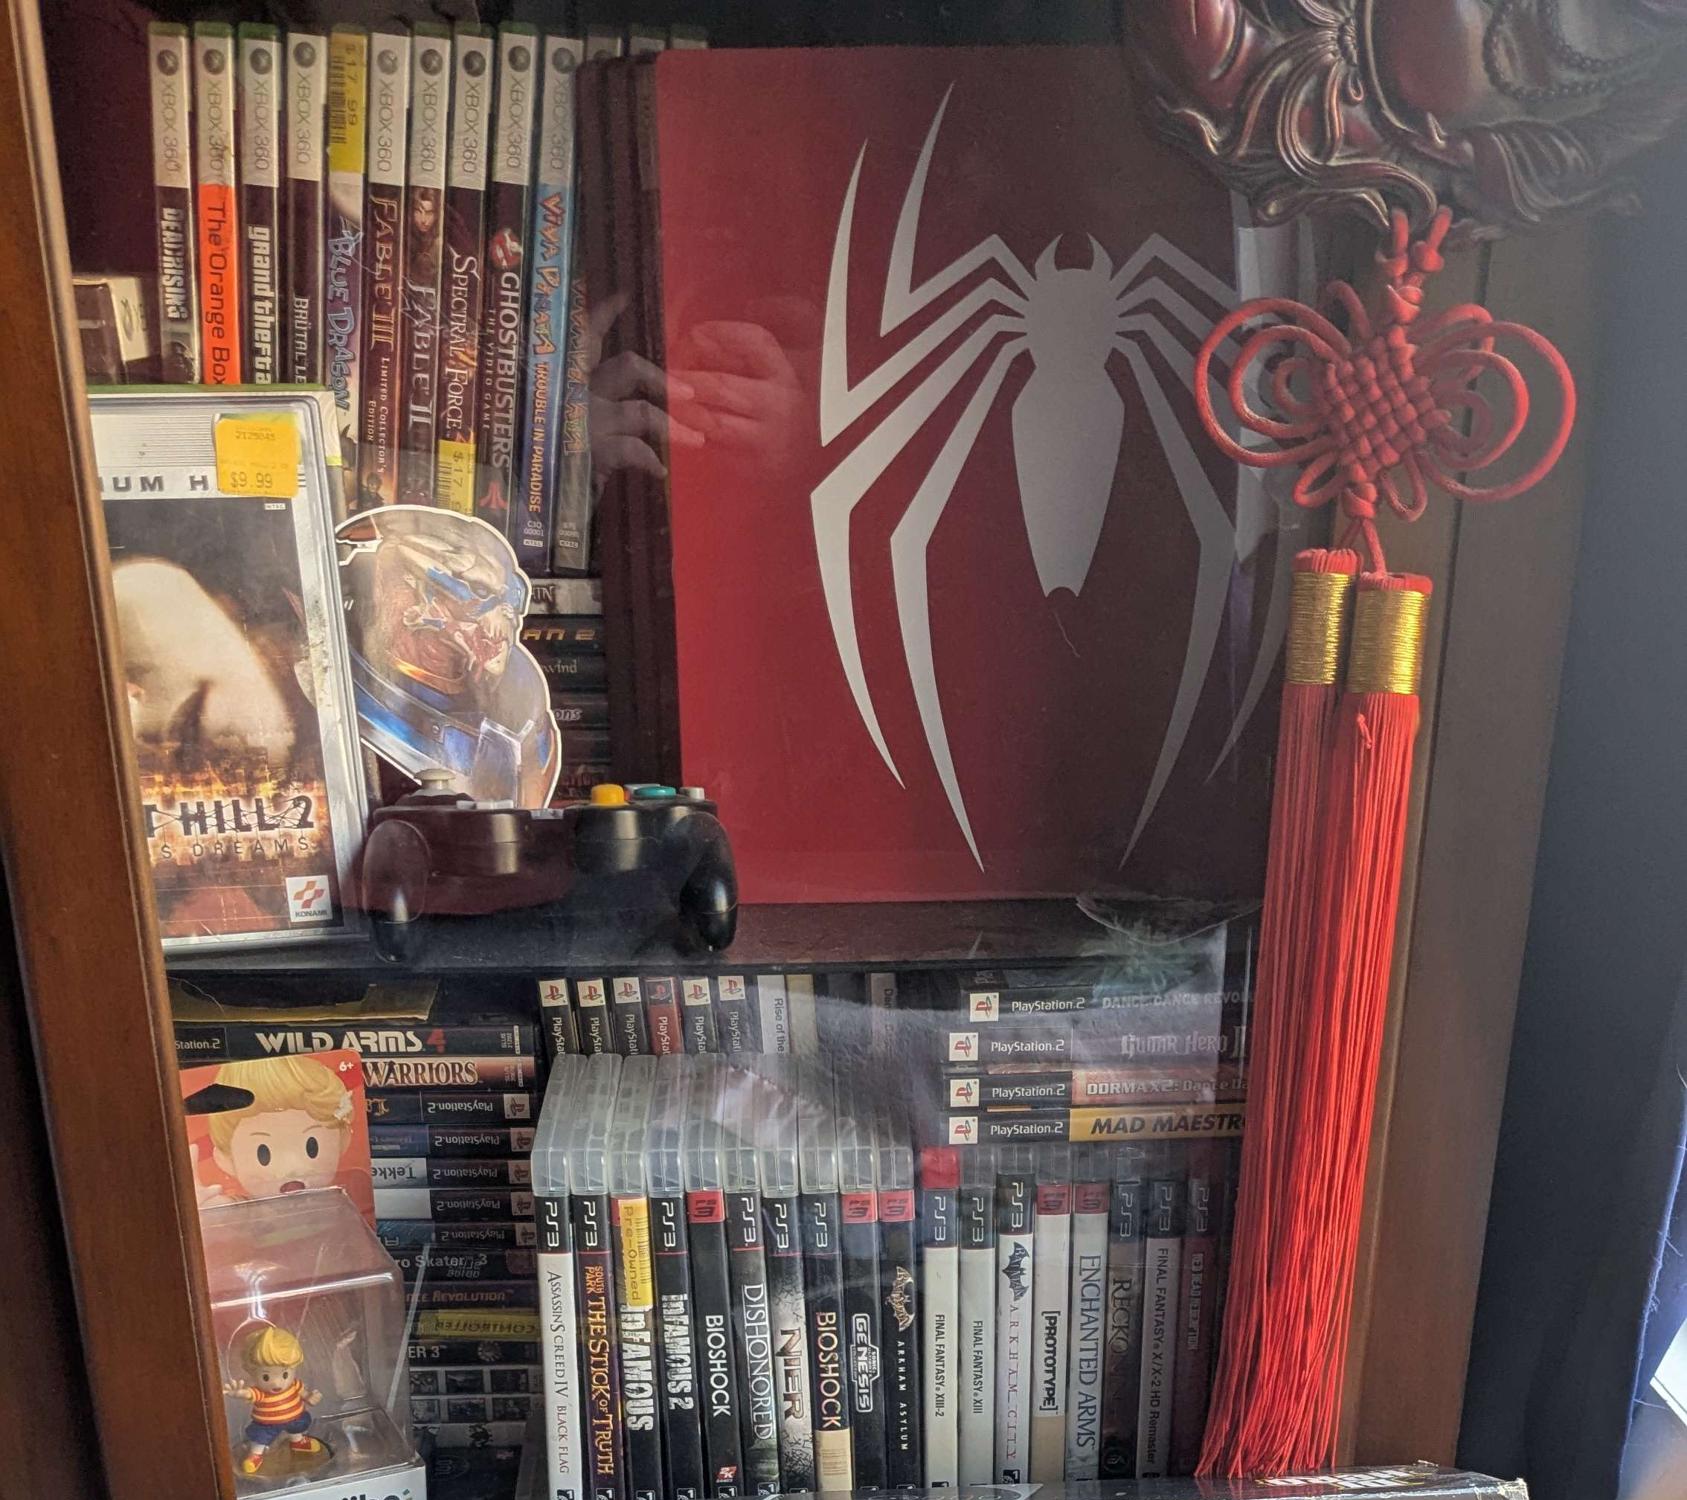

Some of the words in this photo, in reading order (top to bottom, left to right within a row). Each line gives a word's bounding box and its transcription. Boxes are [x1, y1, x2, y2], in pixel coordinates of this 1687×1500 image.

[161, 81, 176, 131] XBOX
[379, 80, 393, 132] XBOX
[464, 81, 479, 134] XBOX
[163, 136, 178, 171] 360
[377, 136, 392, 171] 360
[462, 137, 478, 173] 360
[207, 203, 227, 246] The
[369, 195, 398, 302] FABLE
[206, 253, 228, 339] Orange
[448, 244, 479, 360] SPECTRAL
[371, 309, 396, 350] III
[406, 278, 436, 395] FABLE
[328, 307, 356, 409] DRAGON
[491, 272, 521, 468] GHOSTBUSTERS
[409, 399, 431, 430] II
[445, 367, 468, 431] FORCE
[534, 363, 548, 423] TROUBLE
[533, 426, 544, 441] IN
[230, 472, 274, 489] $9.99
[529, 446, 544, 513] PARADISE
[180, 797, 281, 836] HILL
[292, 795, 314, 829] 2
[193, 837, 309, 857] DREAMS
[295, 909, 328, 918] KONAMI
[256, 1032, 334, 1054] WILD
[342, 1031, 423, 1052] ARMS
[427, 1029, 446, 1052] 4
[339, 1060, 354, 1072] 6+
[361, 1060, 480, 1087] WARRIORS
[1091, 1117, 1145, 1135] MAD
[1152, 1114, 1246, 1132] MAESTR
[545, 1201, 560, 1248] PS3
[741, 1197, 757, 1243] PS3
[1011, 1182, 1024, 1229] PS3
[623, 1206, 641, 1301] Pre-Owned
[585, 1266, 595, 1294] PARK
[594, 1265, 604, 1295] SOUTH
[587, 1297, 607, 1336] THE
[1078, 1255, 1101, 1386] ENCHANTED
[553, 1335, 566, 1378] CREED
[588, 1336, 611, 1400] STICK
[705, 1315, 731, 1417] BIOSHOCK
[743, 1283, 775, 1440] DISHONORED
[816, 1312, 842, 1428] BIOSHOCK
[855, 1318, 871, 1409] GENESIS
[897, 1341, 908, 1391] ARKHAM
[1008, 1305, 1020, 1393] ARKHAM
[554, 1381, 569, 1398] IV
[775, 1329, 804, 1420] NIER
[556, 1405, 569, 1441] BLACK
[600, 1399, 609, 1413] OF
[669, 1396, 694, 1410] 2
[899, 1402, 909, 1450] ASYLUM
[1076, 1391, 1097, 1448] ARMS
[592, 1412, 614, 1475] TRUTH
[1006, 1408, 1018, 1460] CITY
[558, 1445, 570, 1474] FLAG
